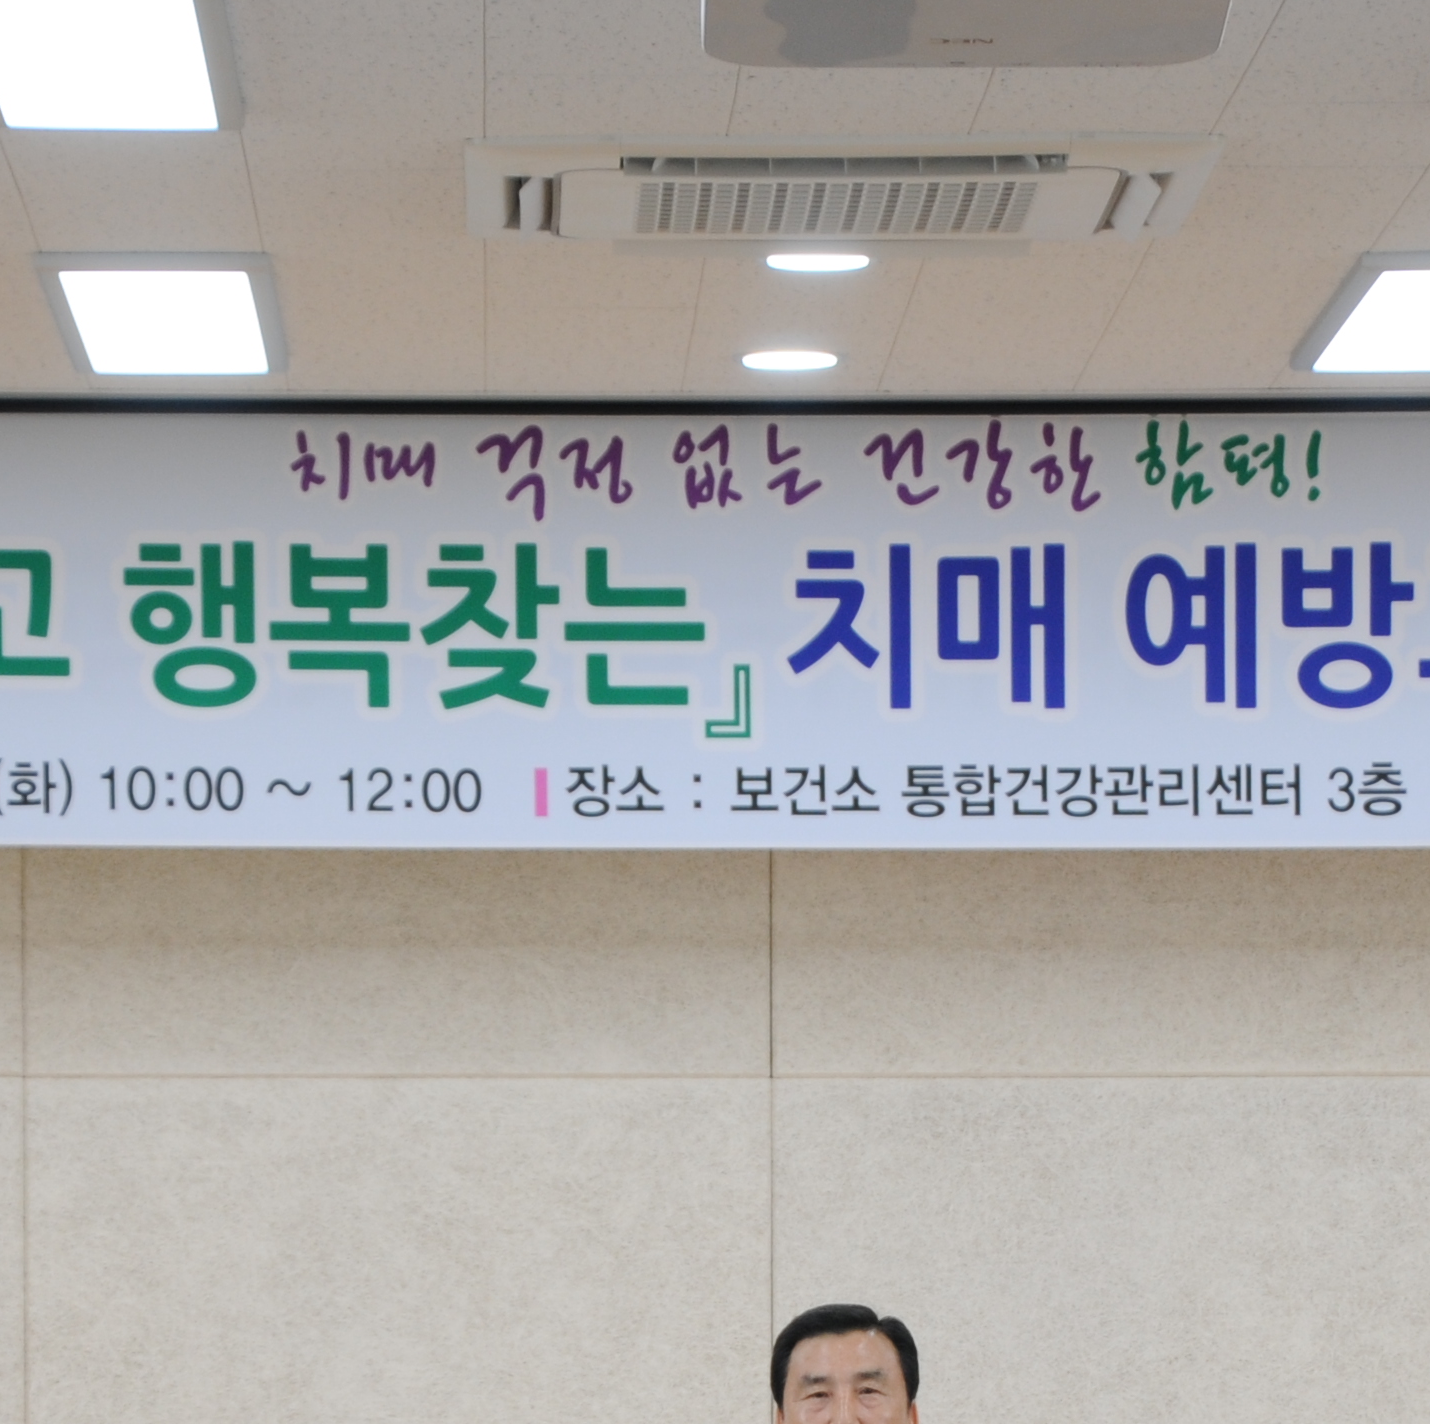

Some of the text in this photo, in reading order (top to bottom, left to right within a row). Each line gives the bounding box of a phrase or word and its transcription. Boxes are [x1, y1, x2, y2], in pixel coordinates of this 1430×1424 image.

[290, 430, 436, 501] 치매
[672, 423, 822, 509] 없는
[863, 420, 1102, 512] 건강한
[1135, 419, 1322, 510] 함평!
[786, 542, 1067, 710] 치매
[101, 764, 245, 812] 10:00
[339, 767, 484, 814] 12:00
[565, 764, 665, 818] 장소
[729, 763, 881, 817] 보건소
[901, 762, 1302, 818] 통합건강관리센터
[1327, 761, 1408, 817] 3층
